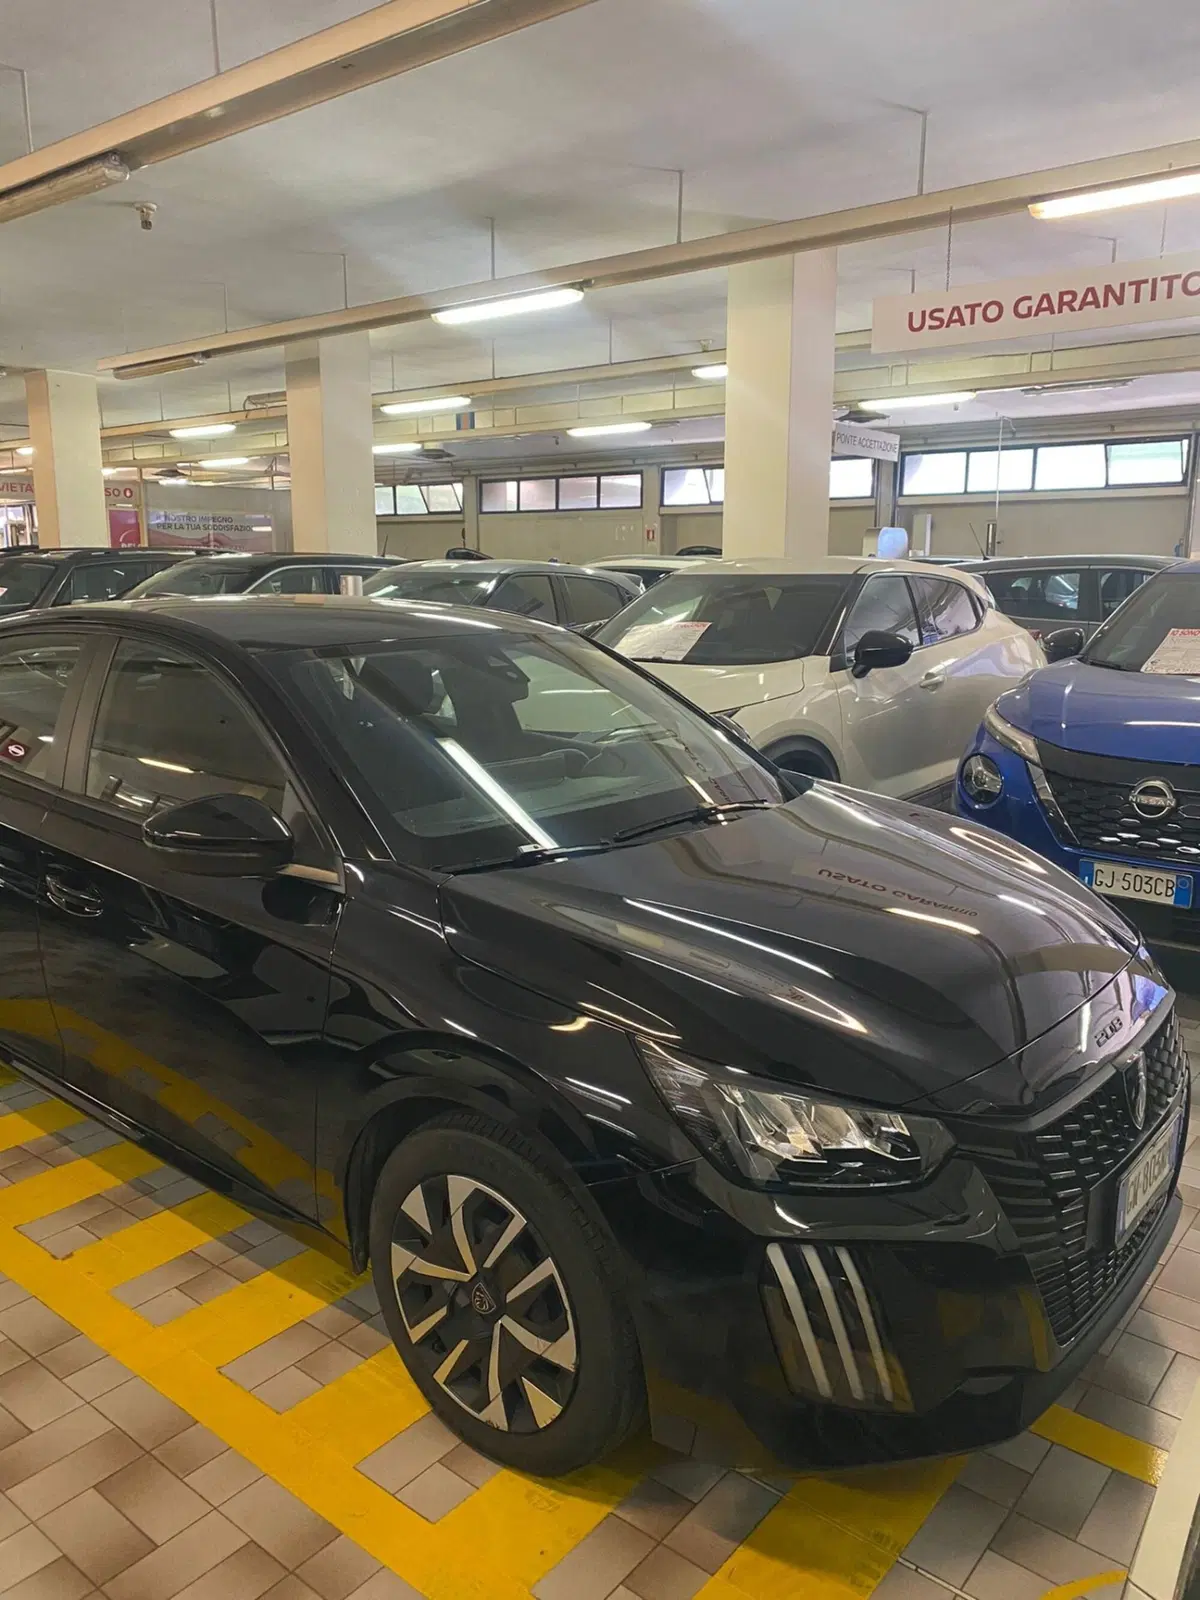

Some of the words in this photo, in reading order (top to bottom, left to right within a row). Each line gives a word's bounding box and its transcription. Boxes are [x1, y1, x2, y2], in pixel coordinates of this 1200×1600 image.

[908, 300, 1004, 332] USATO
[1013, 270, 1200, 319] GARANTITO
[836, 433, 857, 446] PONTE
[858, 436, 898, 454] ACCETTAZIONE
[164, 514, 197, 523] NOSTRO
[186, 523, 202, 531] TUA
[1128, 793, 1176, 808] NISSAN
[1094, 868, 1116, 889] GJ
[1121, 872, 1175, 898] 503CB
